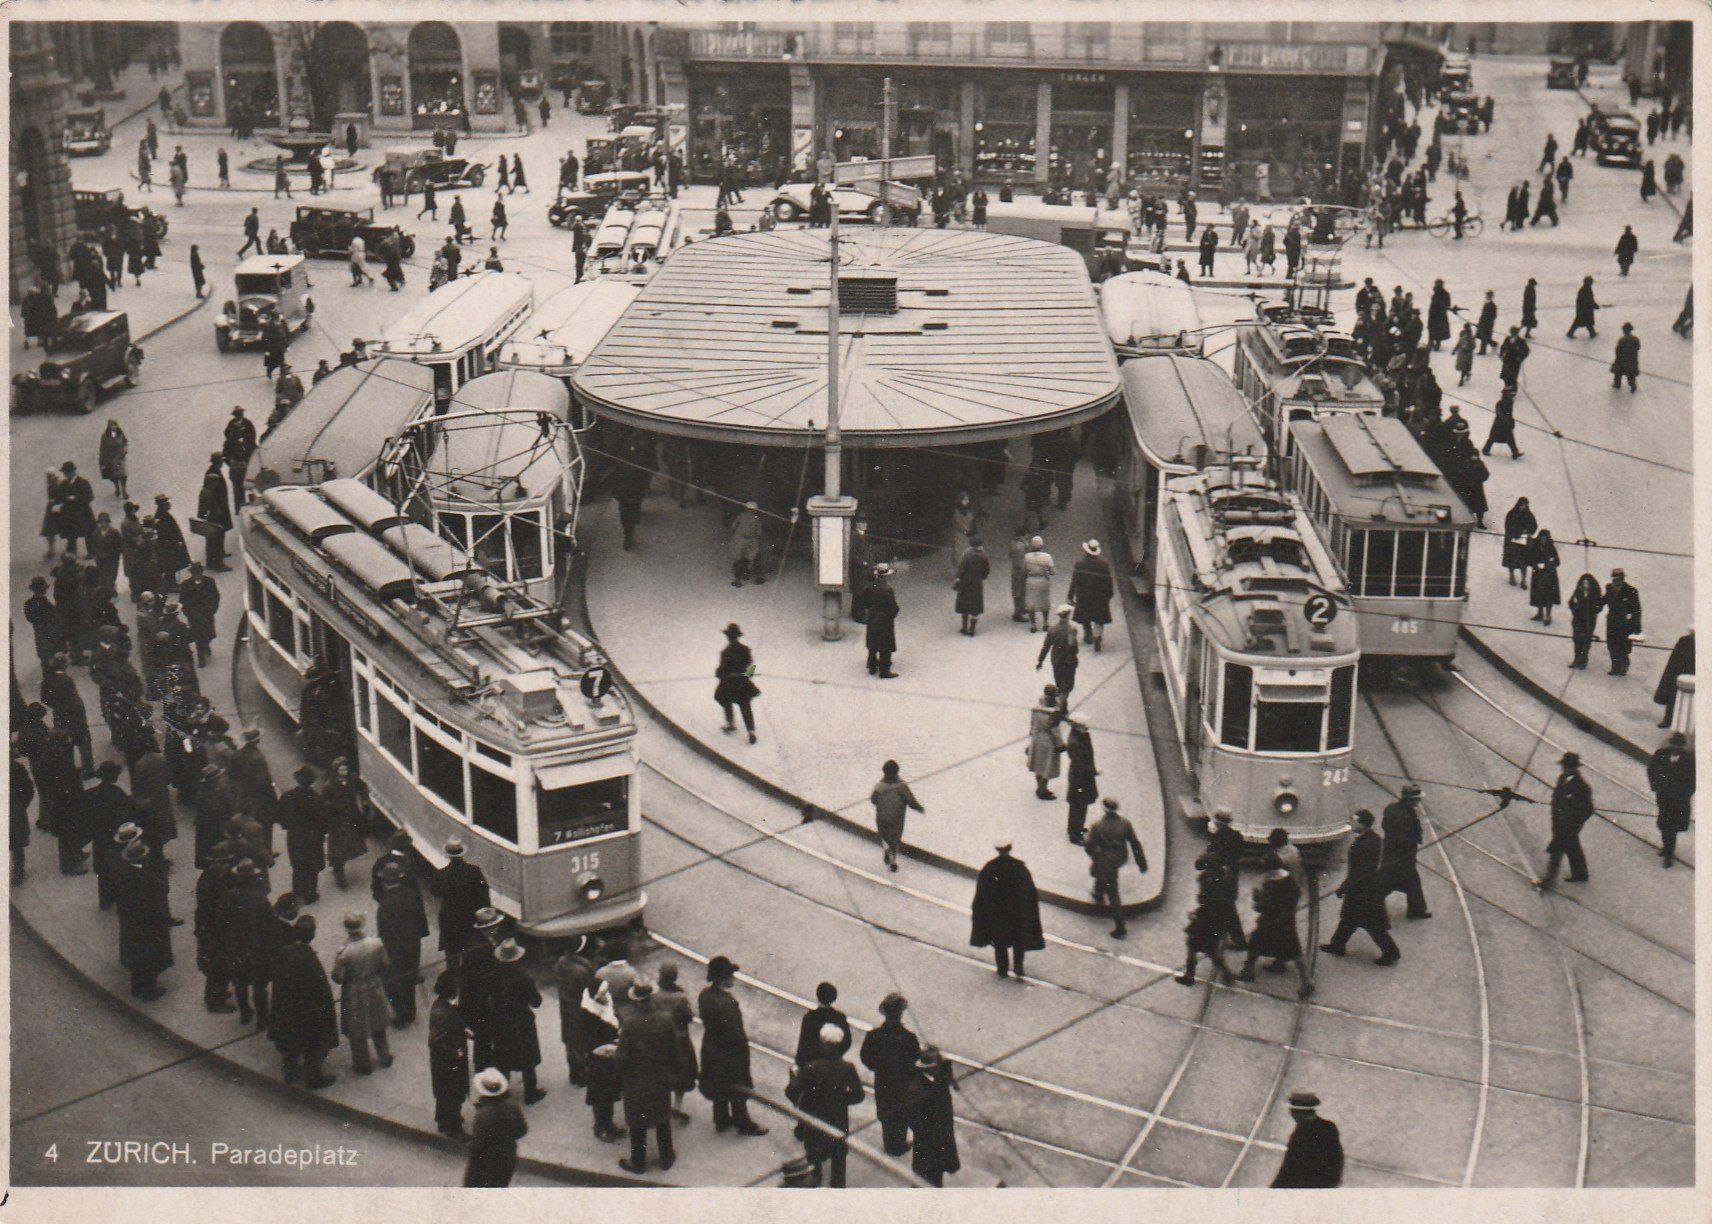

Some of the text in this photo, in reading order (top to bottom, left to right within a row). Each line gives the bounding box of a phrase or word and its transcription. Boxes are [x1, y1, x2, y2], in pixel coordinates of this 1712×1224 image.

[635, 248, 645, 263] 7
[1311, 597, 1328, 622] 2
[588, 669, 604, 697] 7
[553, 830, 562, 842] 7
[571, 851, 600, 874] 315
